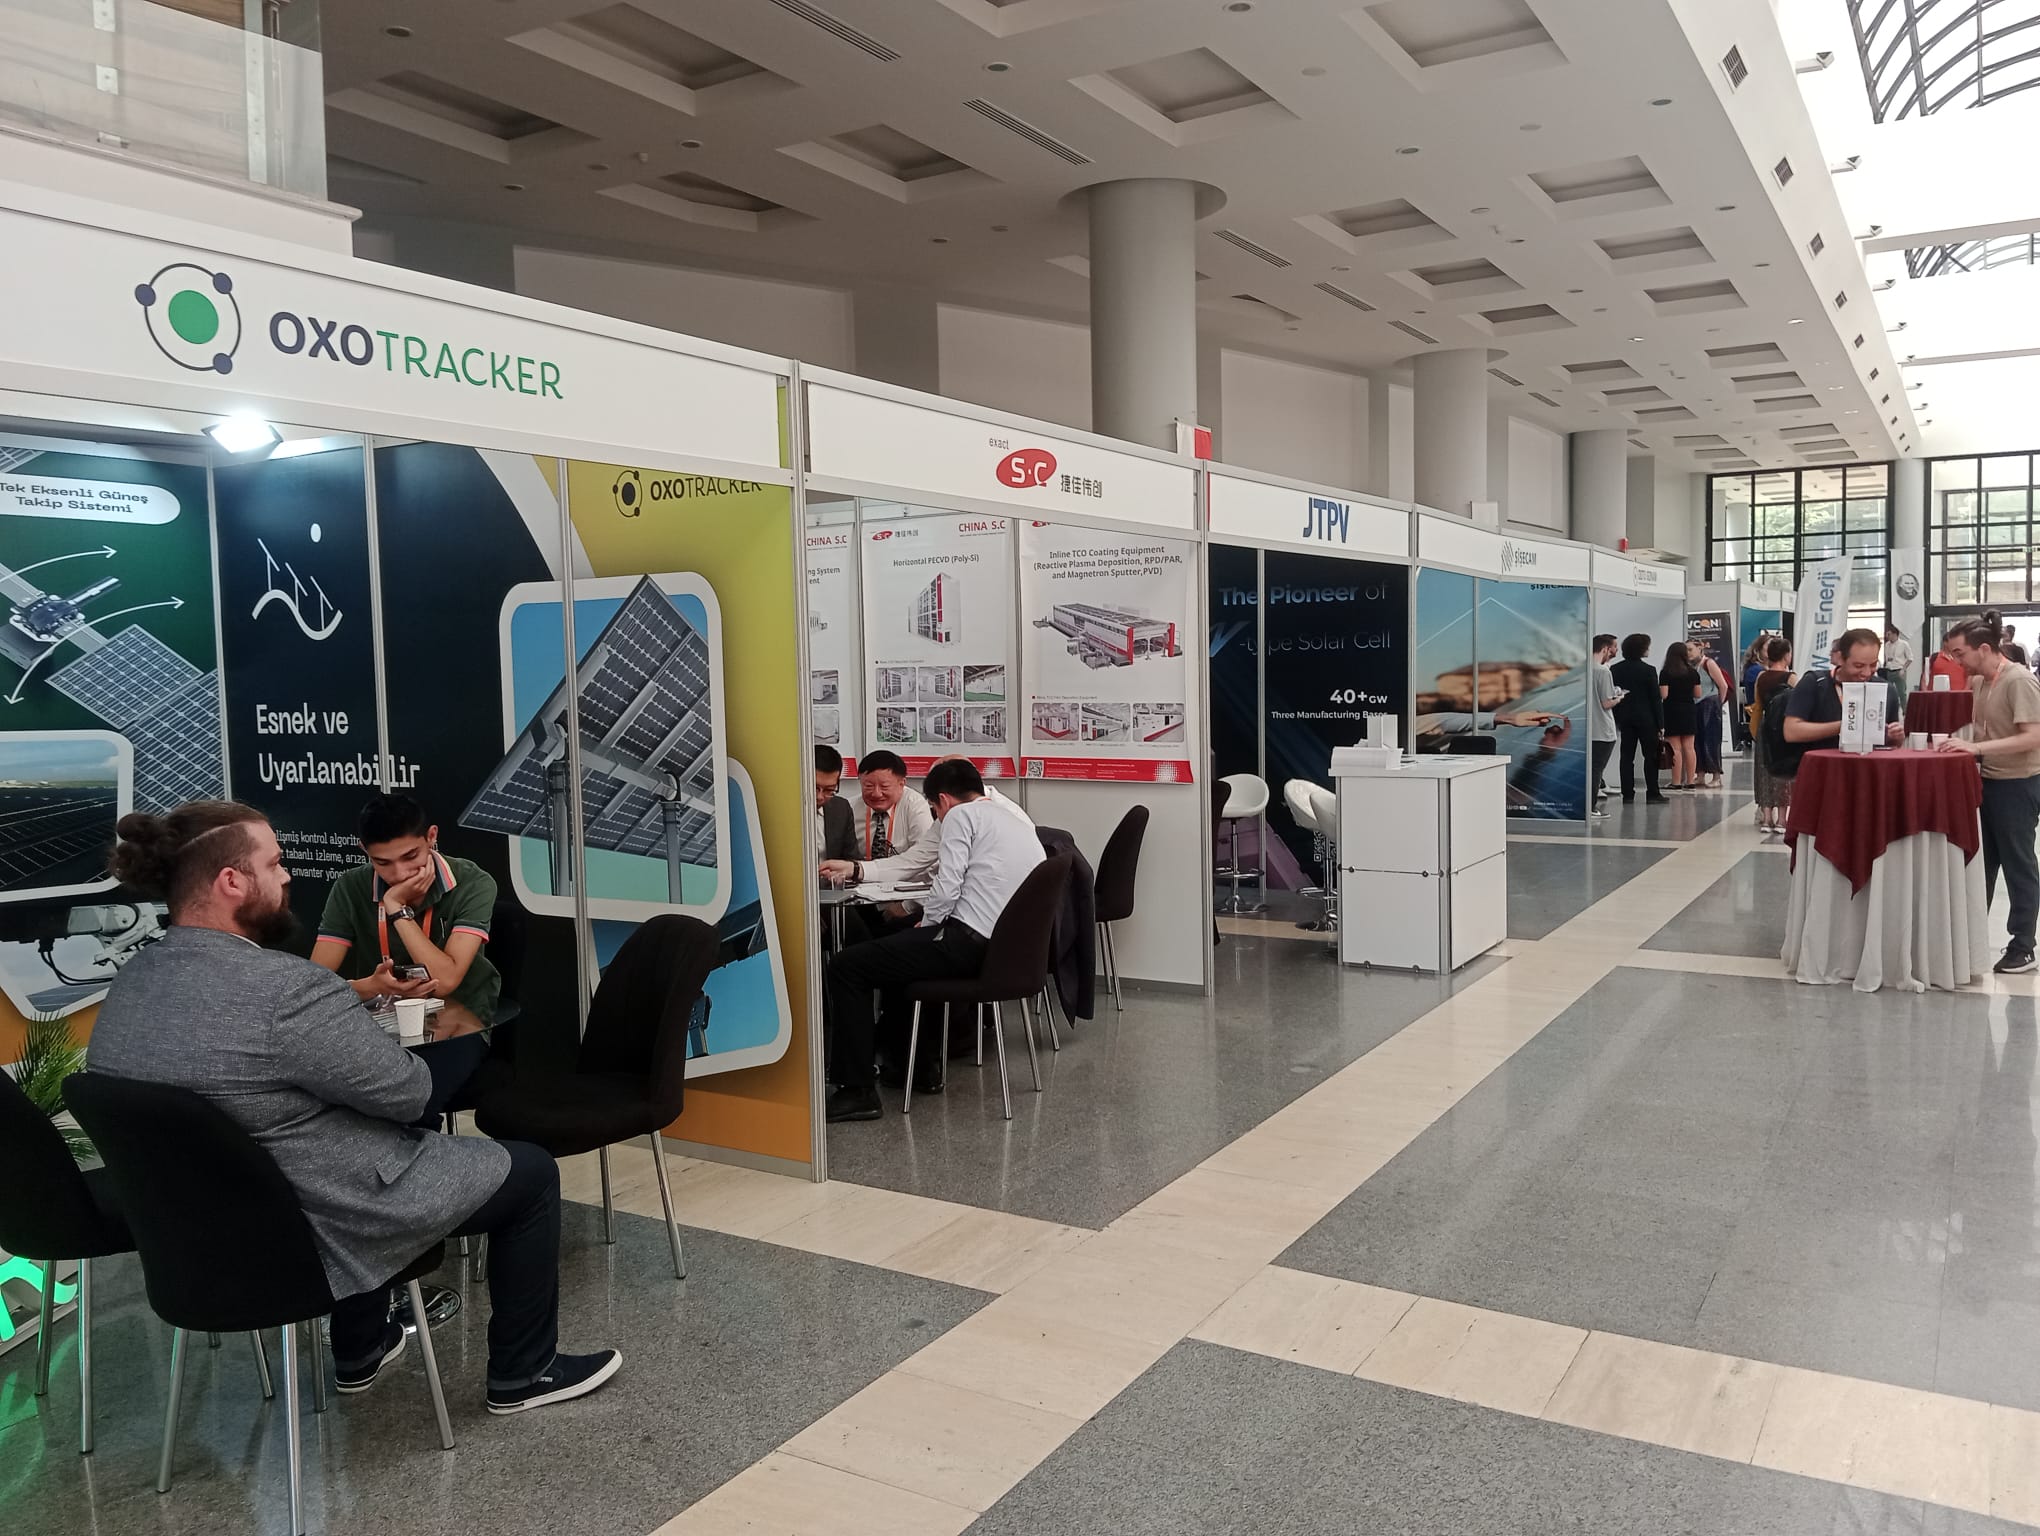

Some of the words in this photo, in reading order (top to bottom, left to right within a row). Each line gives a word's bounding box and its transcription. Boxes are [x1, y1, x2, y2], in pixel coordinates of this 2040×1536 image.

[269, 311, 564, 400] OXOTRACKER
[988, 438, 1010, 450] exact
[0, 482, 26, 493] Tek
[31, 485, 94, 498] Eksenli
[99, 490, 149, 504] Güneş
[1060, 474, 1103, 498] 捷佳伟创
[16, 496, 63, 509] Takip
[68, 500, 133, 513] Sistemi
[958, 522, 988, 532] CHINA
[991, 520, 1006, 530] S.C
[1303, 497, 1350, 543] JTPV
[806, 538, 832, 546] CHINA
[893, 557, 927, 567] Horizontal
[928, 556, 950, 565] PECVD
[951, 554, 980, 564] (Poly-Si)
[1050, 551, 1071, 559] Inline
[1072, 550, 1087, 558] TCO
[1088, 549, 1119, 558] Coating
[1121, 546, 1165, 556] Equipment
[816, 567, 841, 575] System
[1033, 561, 1067, 571] (Reactive
[1069, 560, 1096, 568] Plasma
[1098, 558, 1143, 567] Deposition,
[1144, 556, 1183, 565] RPD/PAR,
[1052, 571, 1066, 579] and
[1067, 570, 1109, 580] Magnetron
[1218, 587, 1258, 606] The
[1269, 583, 1359, 605] Pioneer
[1365, 580, 1388, 600] of
[1814, 571, 1840, 625] Enerji
[1298, 632, 1346, 651] Solar
[1353, 630, 1391, 649] Cell
[256, 702, 317, 735] Esnek
[323, 711, 349, 735] ve
[1271, 711, 1295, 719] Three
[1297, 710, 1360, 720] Manufacturing
[258, 752, 421, 792] Uyarlanabilir
[276, 829, 300, 844] lişmiş
[300, 831, 328, 844] kontrol
[329, 832, 361, 848] algorit
[286, 848, 313, 861] tabanlı
[315, 849, 344, 864] izleme,
[345, 854, 367, 865] arıza
[291, 867, 323, 878] envanter
